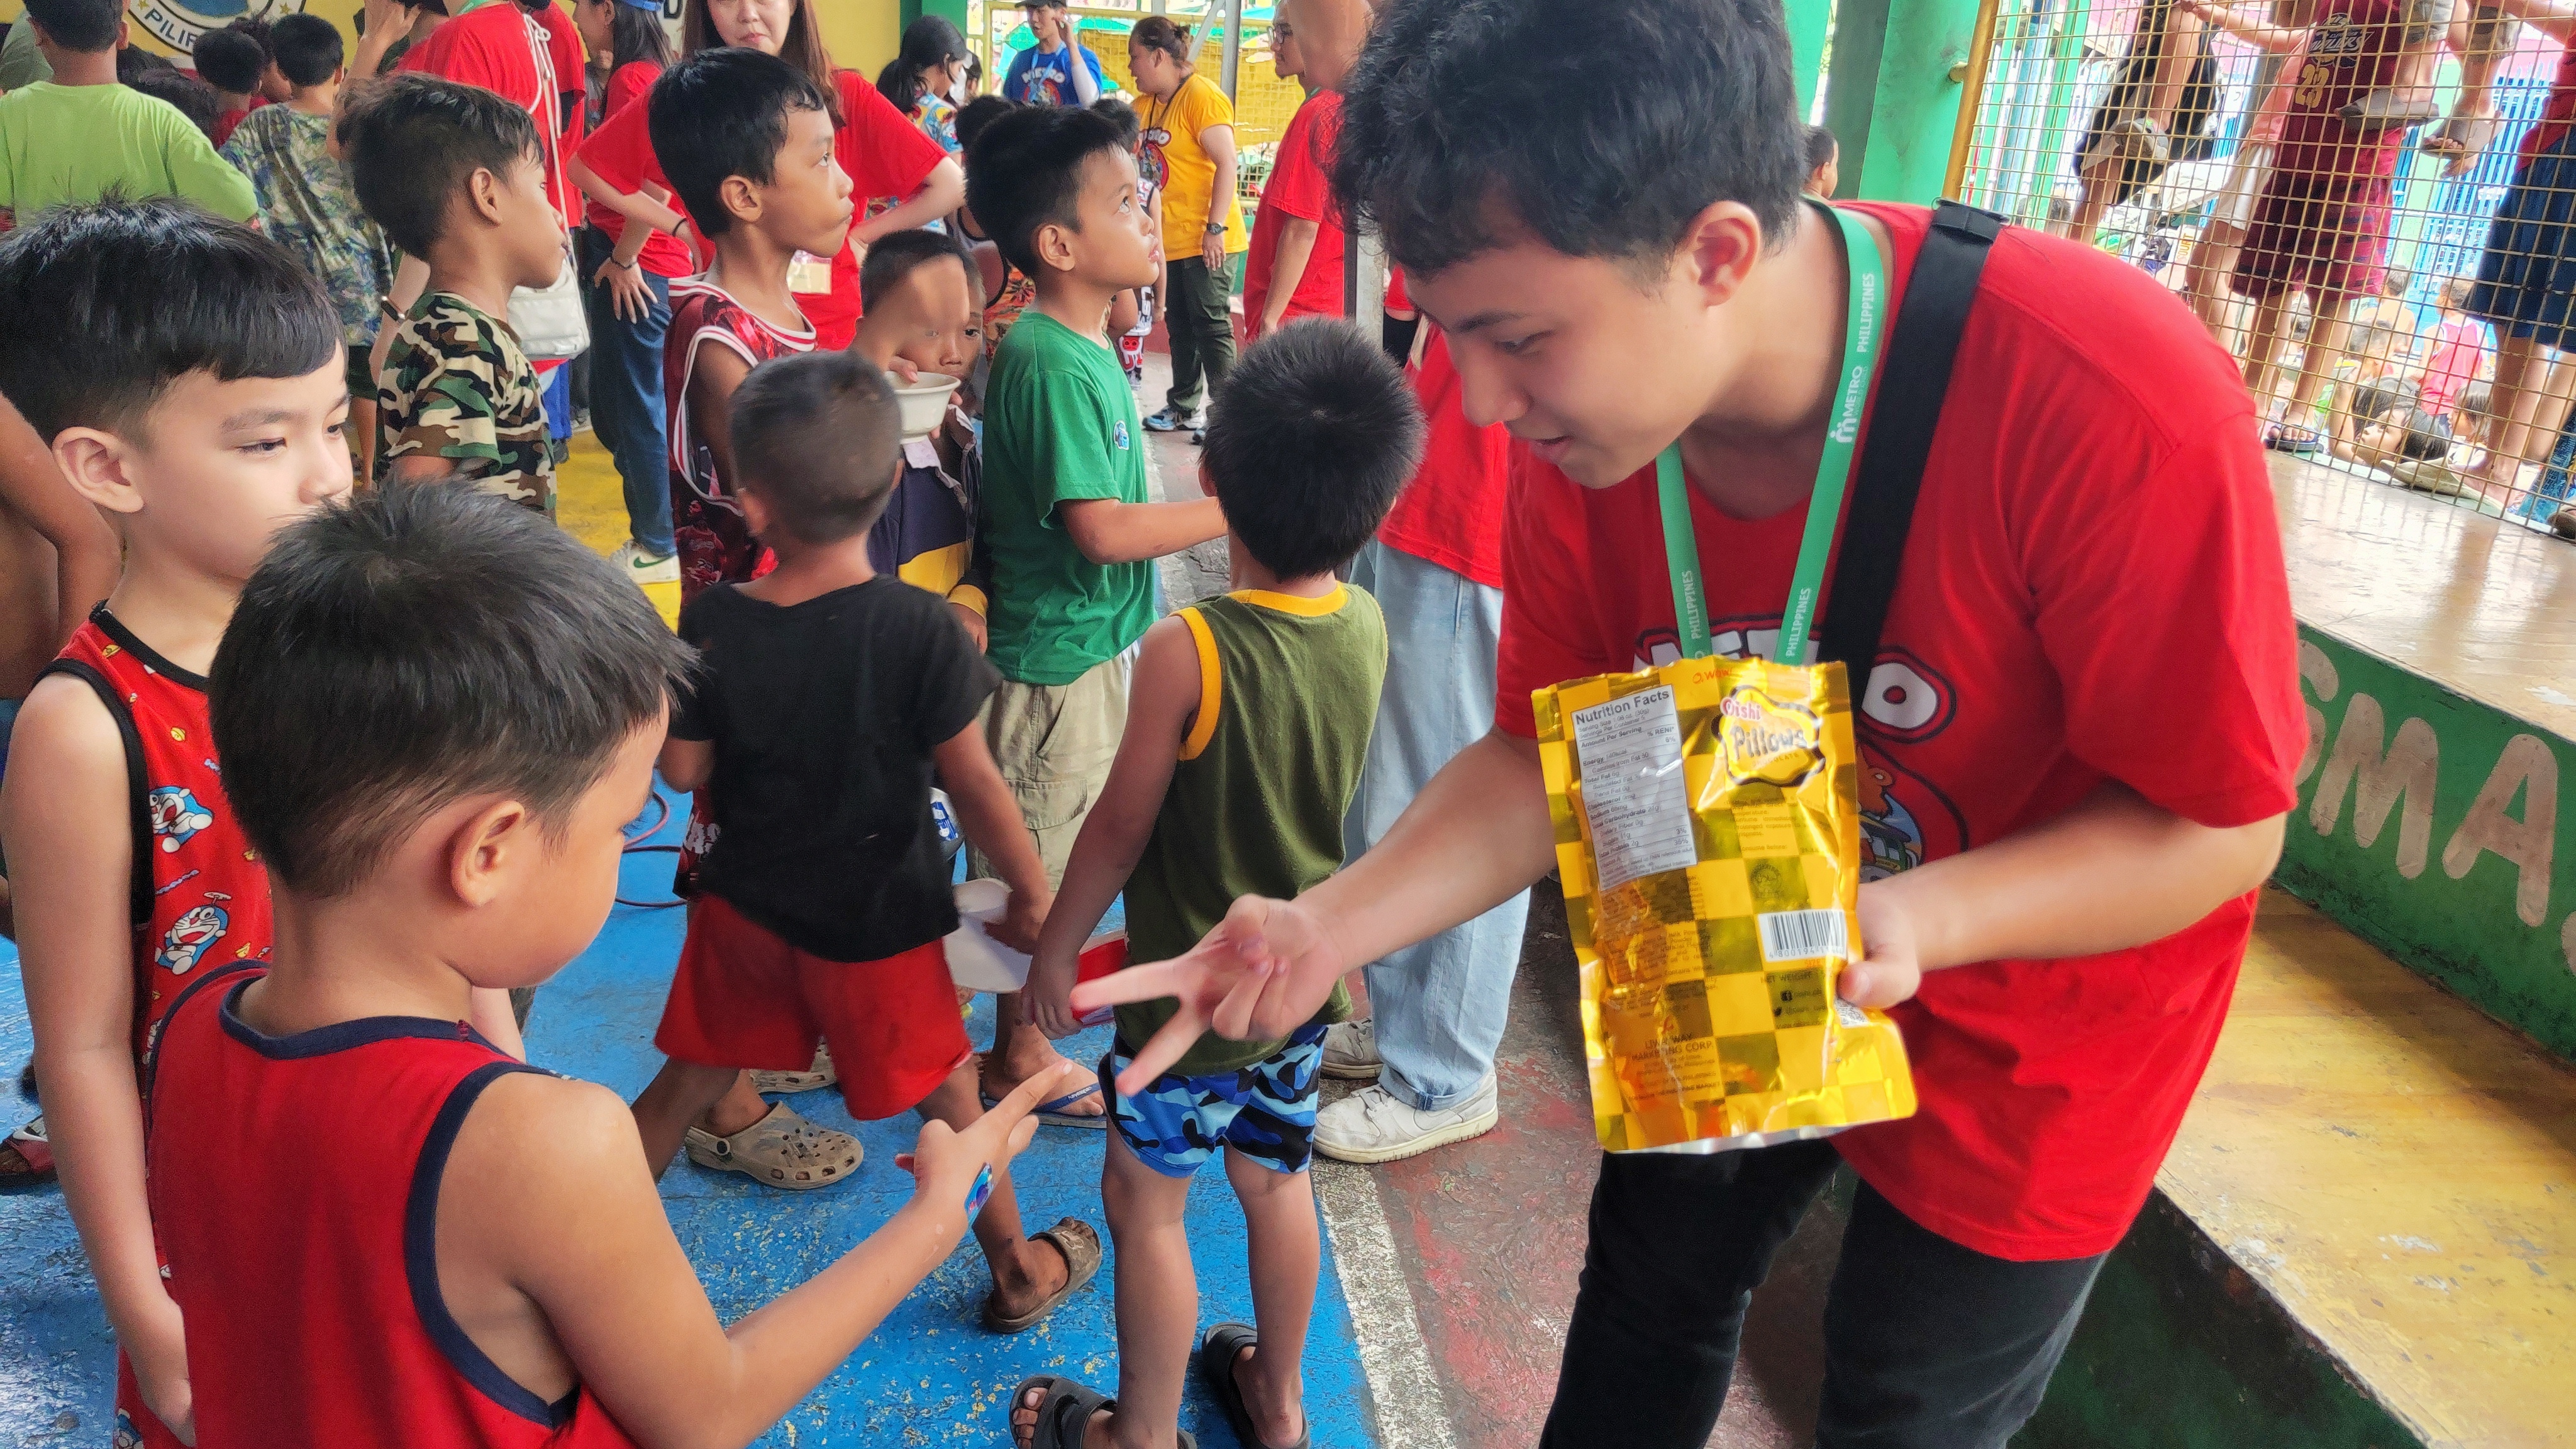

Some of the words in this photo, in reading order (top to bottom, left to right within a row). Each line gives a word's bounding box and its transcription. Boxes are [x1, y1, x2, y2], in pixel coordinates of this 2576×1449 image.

[2296, 64, 2329, 108] 23
[1857, 272, 1875, 353] PHILIPPINES
[1843, 365, 1862, 416] METRO
[1682, 570, 1702, 639] PHILIPPINES
[1785, 588, 1811, 657] PHILIPPINES
[1576, 701, 1631, 724] Nutrition
[1633, 690, 1670, 708] Facts
[1721, 697, 1761, 721] Oishi
[1580, 737, 1606, 748] Amount
[1618, 726, 1642, 737] Serving
[1731, 725, 1807, 760] Pillows
[1604, 809, 1646, 824] Carbohydrate
[2296, 639, 2576, 976] SMA
